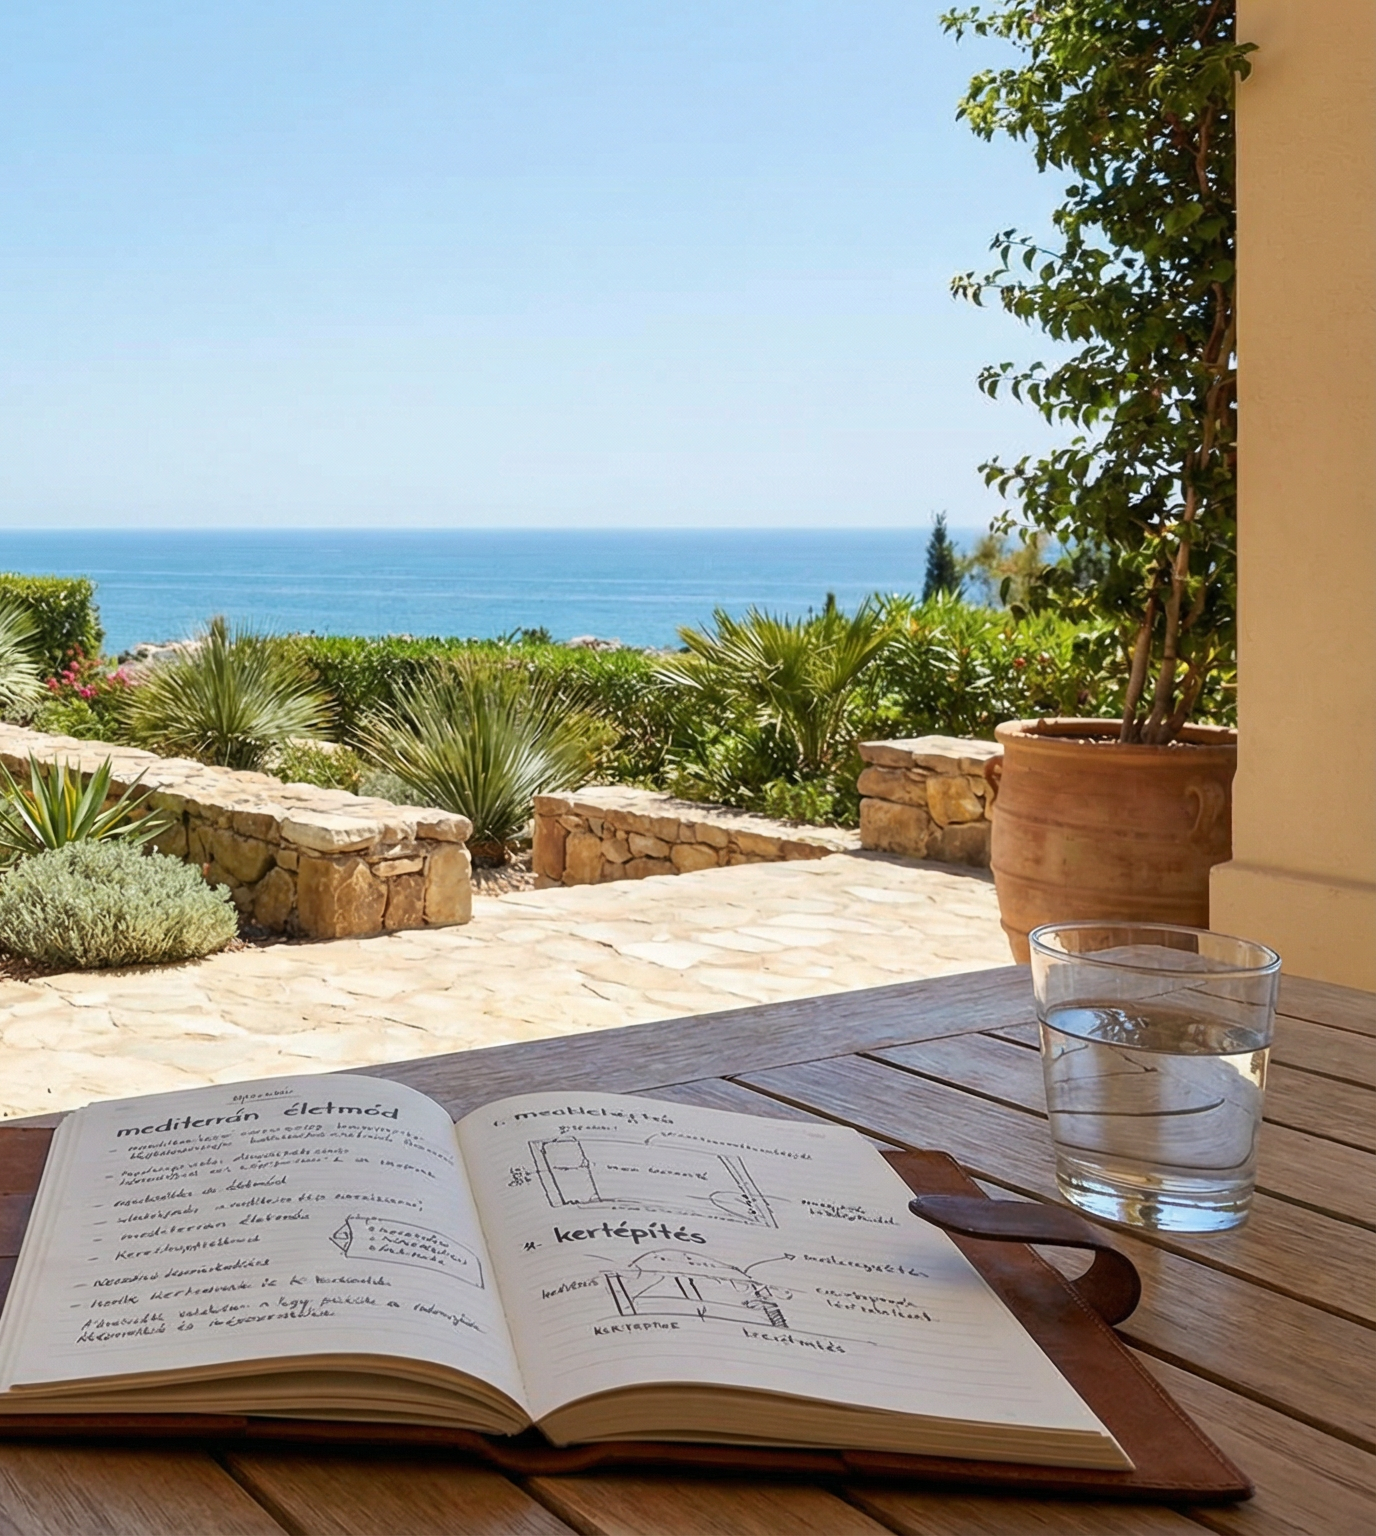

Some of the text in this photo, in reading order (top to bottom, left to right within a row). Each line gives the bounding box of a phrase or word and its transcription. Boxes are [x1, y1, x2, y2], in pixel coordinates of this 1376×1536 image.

[117, 1108, 260, 1138] mediterrán
[283, 1101, 400, 1120] életmód
[554, 1221, 707, 1245] kertépítés
